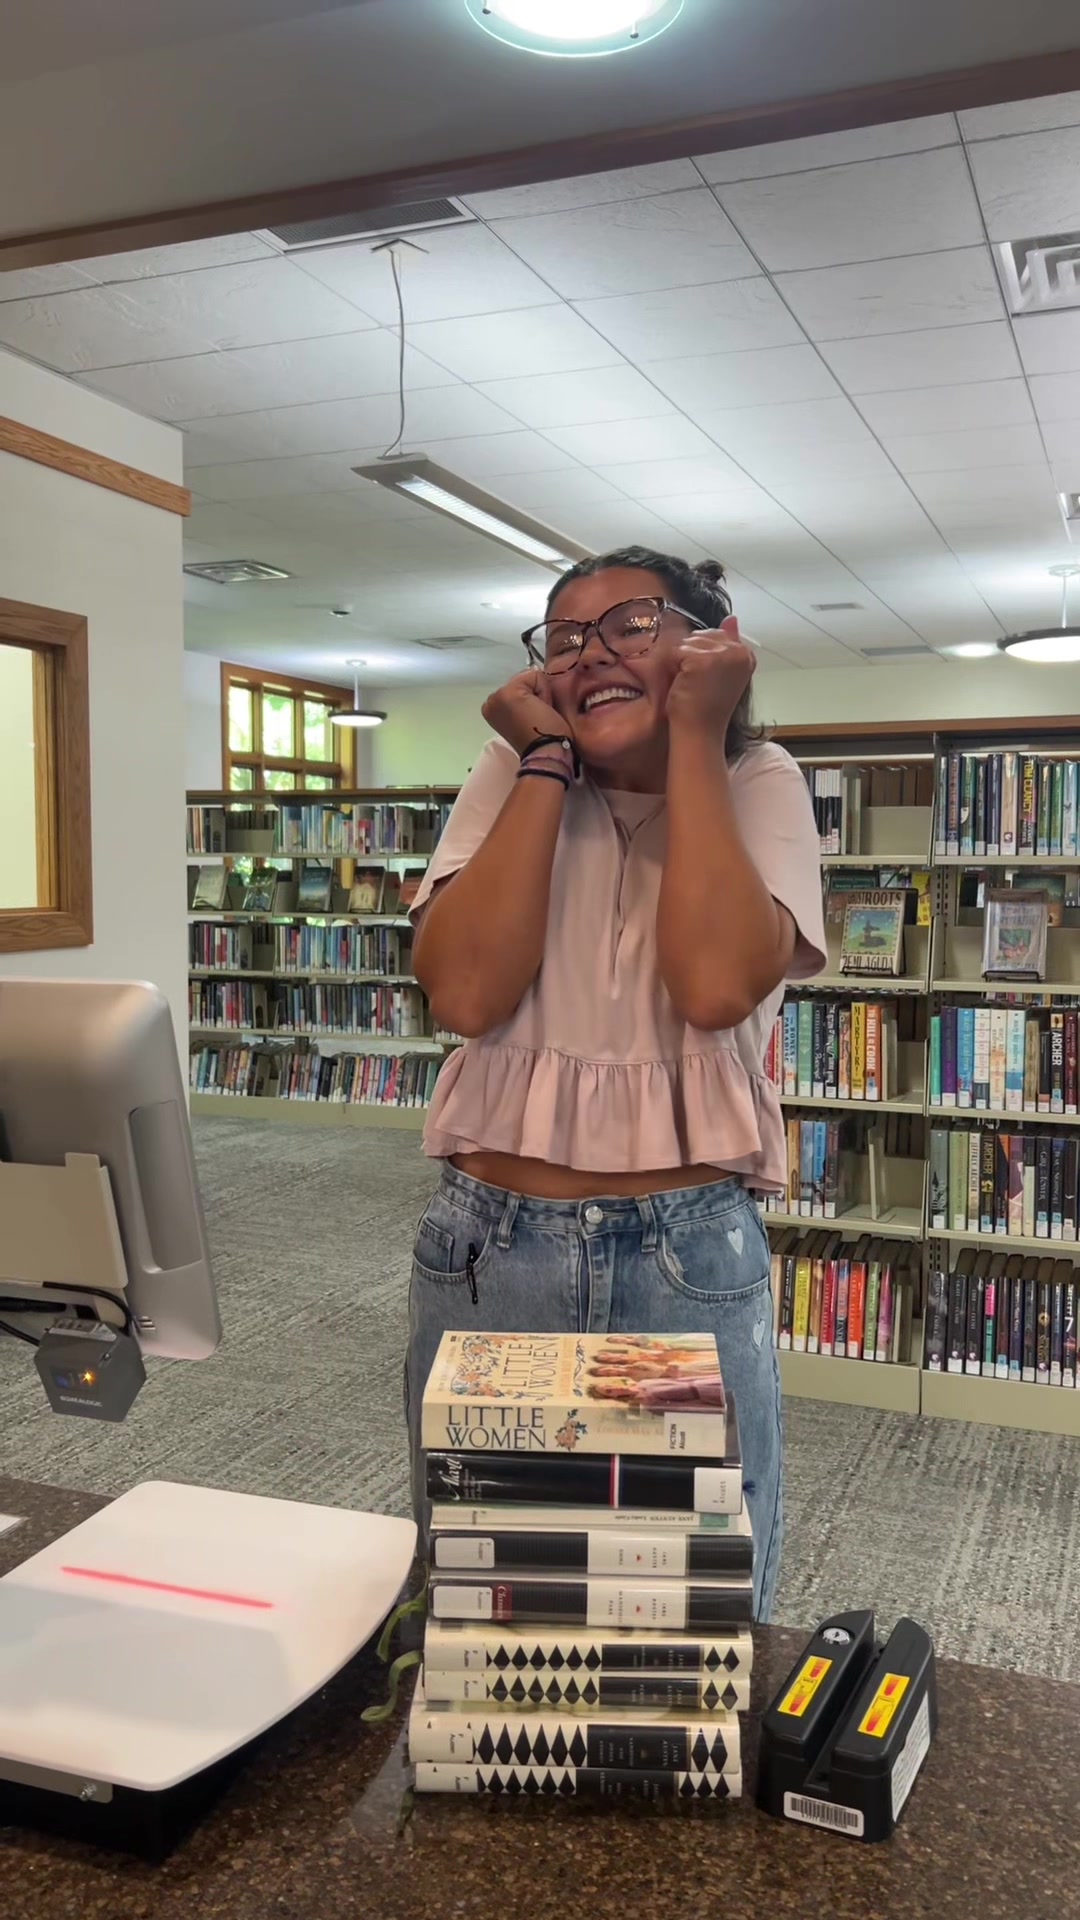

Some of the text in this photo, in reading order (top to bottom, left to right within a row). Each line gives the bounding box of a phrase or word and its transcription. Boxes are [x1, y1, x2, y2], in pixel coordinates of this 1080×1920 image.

[1024, 760, 1034, 814] TOM CLANCY
[1052, 1032, 1062, 1066] ARCHER
[983, 1142, 993, 1174] ARCHER
[500, 1343, 533, 1387] LITTLE
[528, 1336, 559, 1388] WOMEN
[448, 1405, 544, 1428] LITTLE
[445, 1426, 546, 1450] WOMEN
